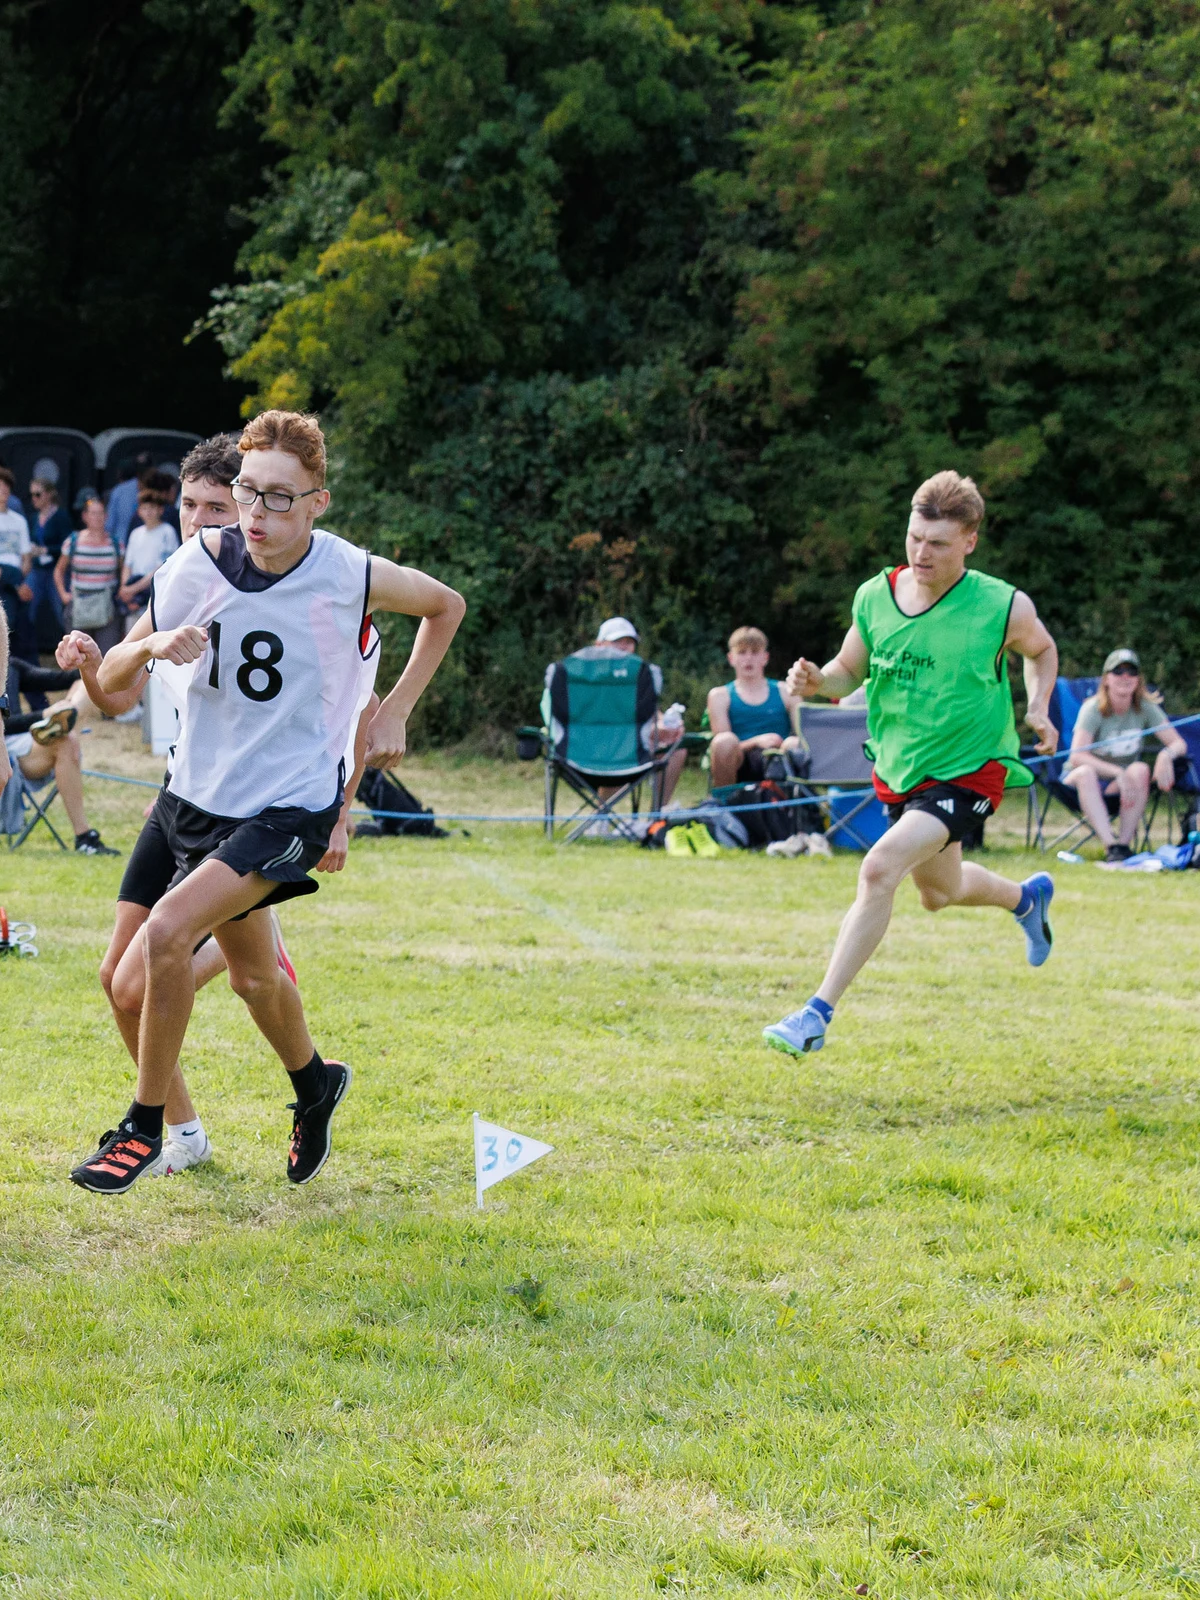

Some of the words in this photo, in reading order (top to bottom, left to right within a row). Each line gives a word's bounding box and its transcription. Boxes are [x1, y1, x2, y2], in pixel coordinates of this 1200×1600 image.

[207, 619, 284, 702] 18
[902, 651, 936, 670] Park
[481, 1135, 524, 1172] 30
